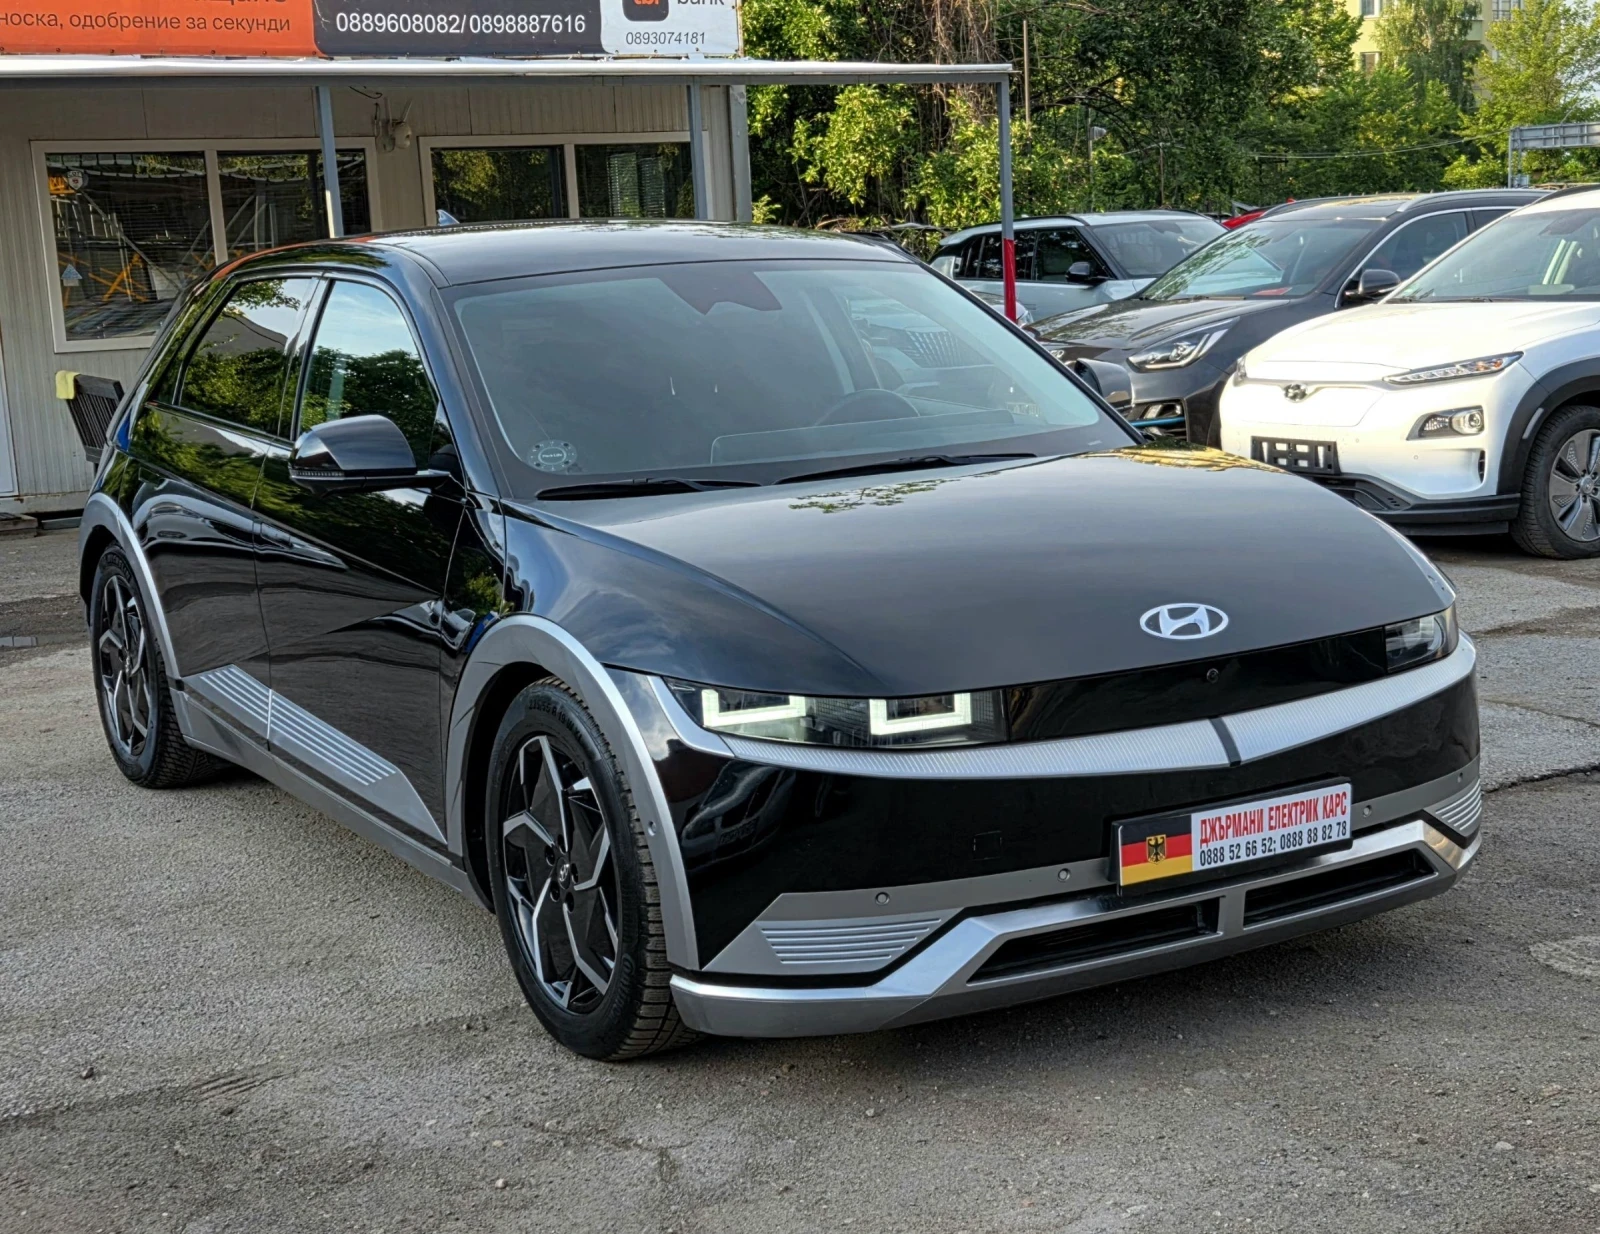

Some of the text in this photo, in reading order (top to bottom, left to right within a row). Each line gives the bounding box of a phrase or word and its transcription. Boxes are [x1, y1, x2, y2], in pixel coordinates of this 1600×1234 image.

[69, 12, 181, 32] одобрение
[186, 17, 207, 30] за
[212, 17, 290, 34] секунди
[336, 12, 586, 33] 0889608082/0898887616
[625, 31, 705, 45] 0893074181
[1200, 791, 1347, 848] ДЖЪРМАНИ ЕЛЕКТРИК КАРС
[1200, 846, 1225, 866] 0888
[1229, 843, 1241, 860] 52
[1245, 840, 1257, 857] 66
[1280, 831, 1303, 850] 0888
[1307, 827, 1318, 844] 88
[1322, 824, 1333, 841] 82
[1336, 820, 1347, 837] 78
